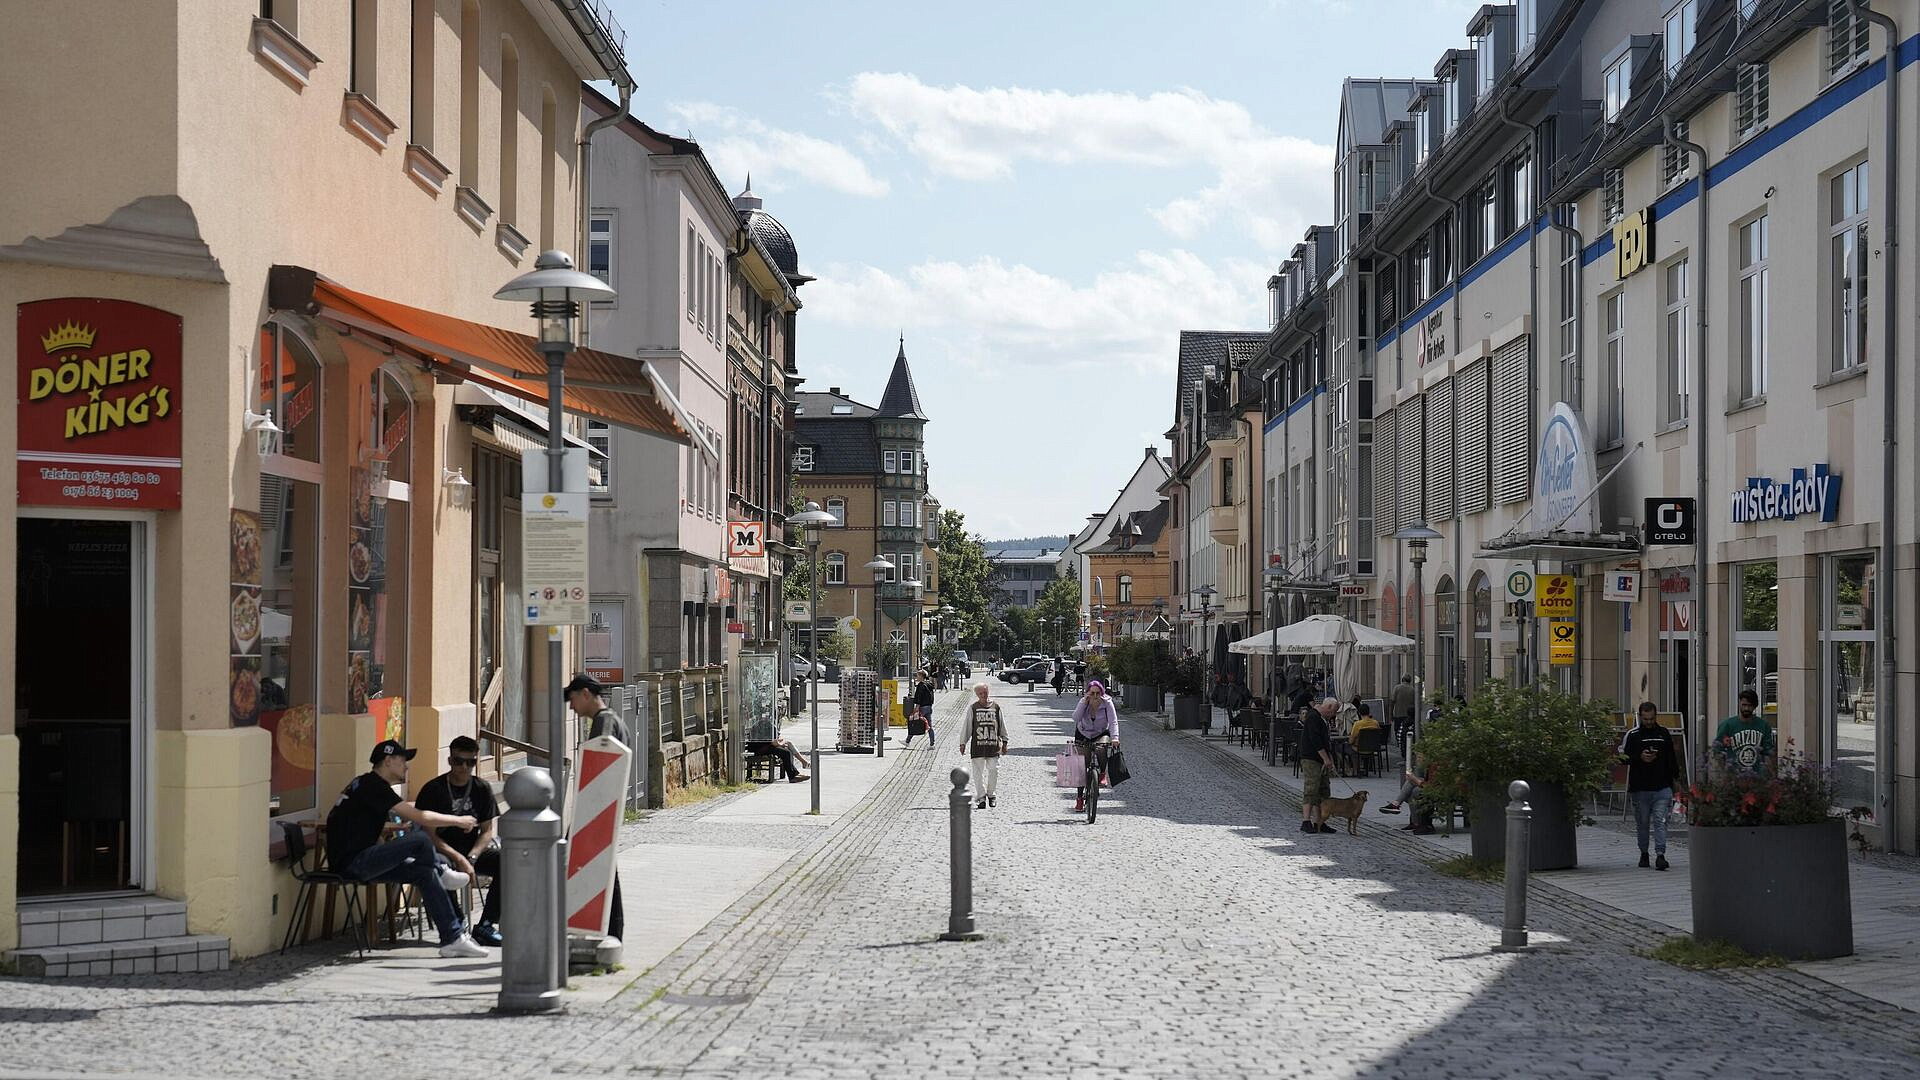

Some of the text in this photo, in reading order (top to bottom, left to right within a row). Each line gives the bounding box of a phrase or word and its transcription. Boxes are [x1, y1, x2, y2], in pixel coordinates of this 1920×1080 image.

[30, 349, 151, 400] DÖNER
[40, 468, 160, 485] Telefon 03675 469 80 80
[63, 486, 139, 500] 0176 86 23 1004
[737, 532, 755, 546] M
[1514, 576, 1525, 591] H
[1343, 587, 1364, 595] NKD
[1540, 597, 1573, 607] LOTTO
